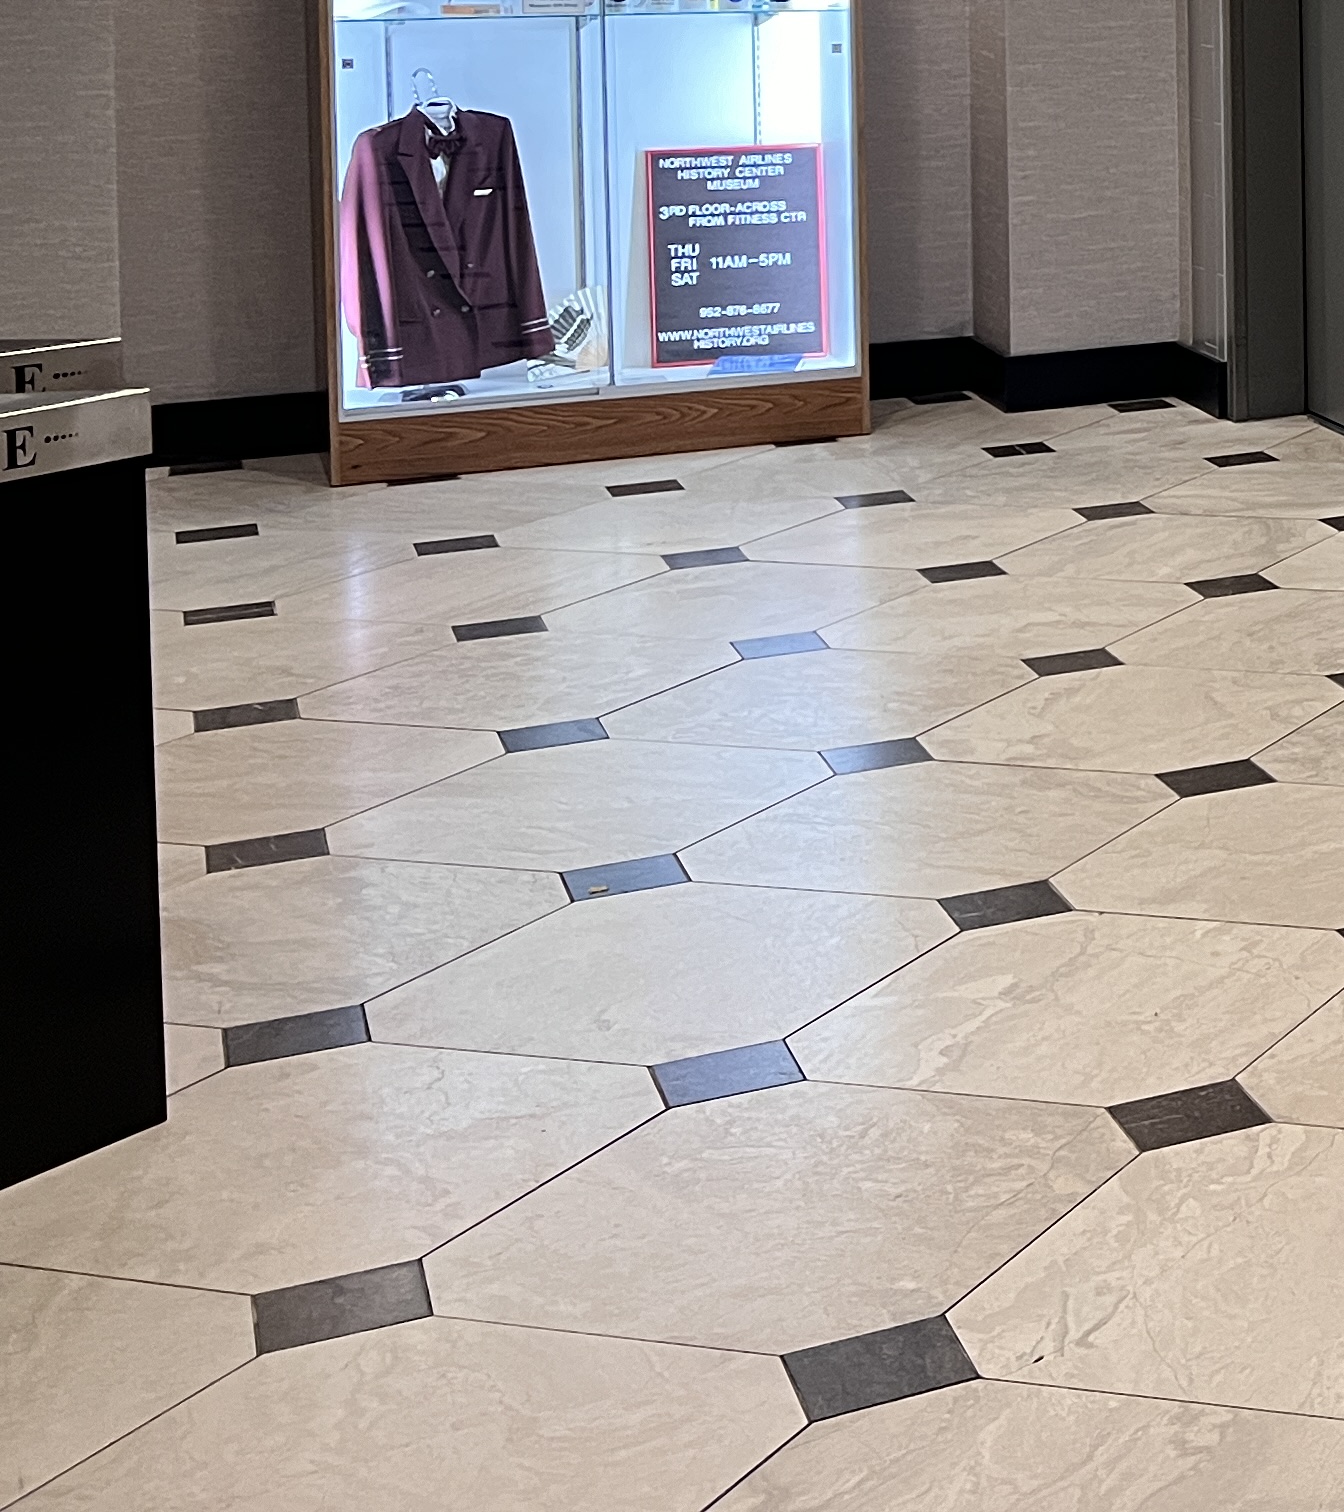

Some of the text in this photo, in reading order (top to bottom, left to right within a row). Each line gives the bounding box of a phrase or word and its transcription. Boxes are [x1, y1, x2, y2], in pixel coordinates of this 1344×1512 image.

[659, 153, 792, 169] NORTHWEST AIRLINES
[677, 166, 784, 180] HISTORY CENTER
[707, 178, 760, 190] MUSEUM
[659, 201, 787, 220] 3RD FLOOR-ACROSS
[689, 211, 807, 228] FROM FITNESS CTR
[668, 243, 700, 257] THU
[671, 258, 697, 272] FRI
[671, 272, 700, 287] SAT
[658, 321, 815, 342] WWW.NORTHWESTAIRLINES
[693, 334, 769, 349] HISTORY.ORG
[2, 425, 38, 472] E
